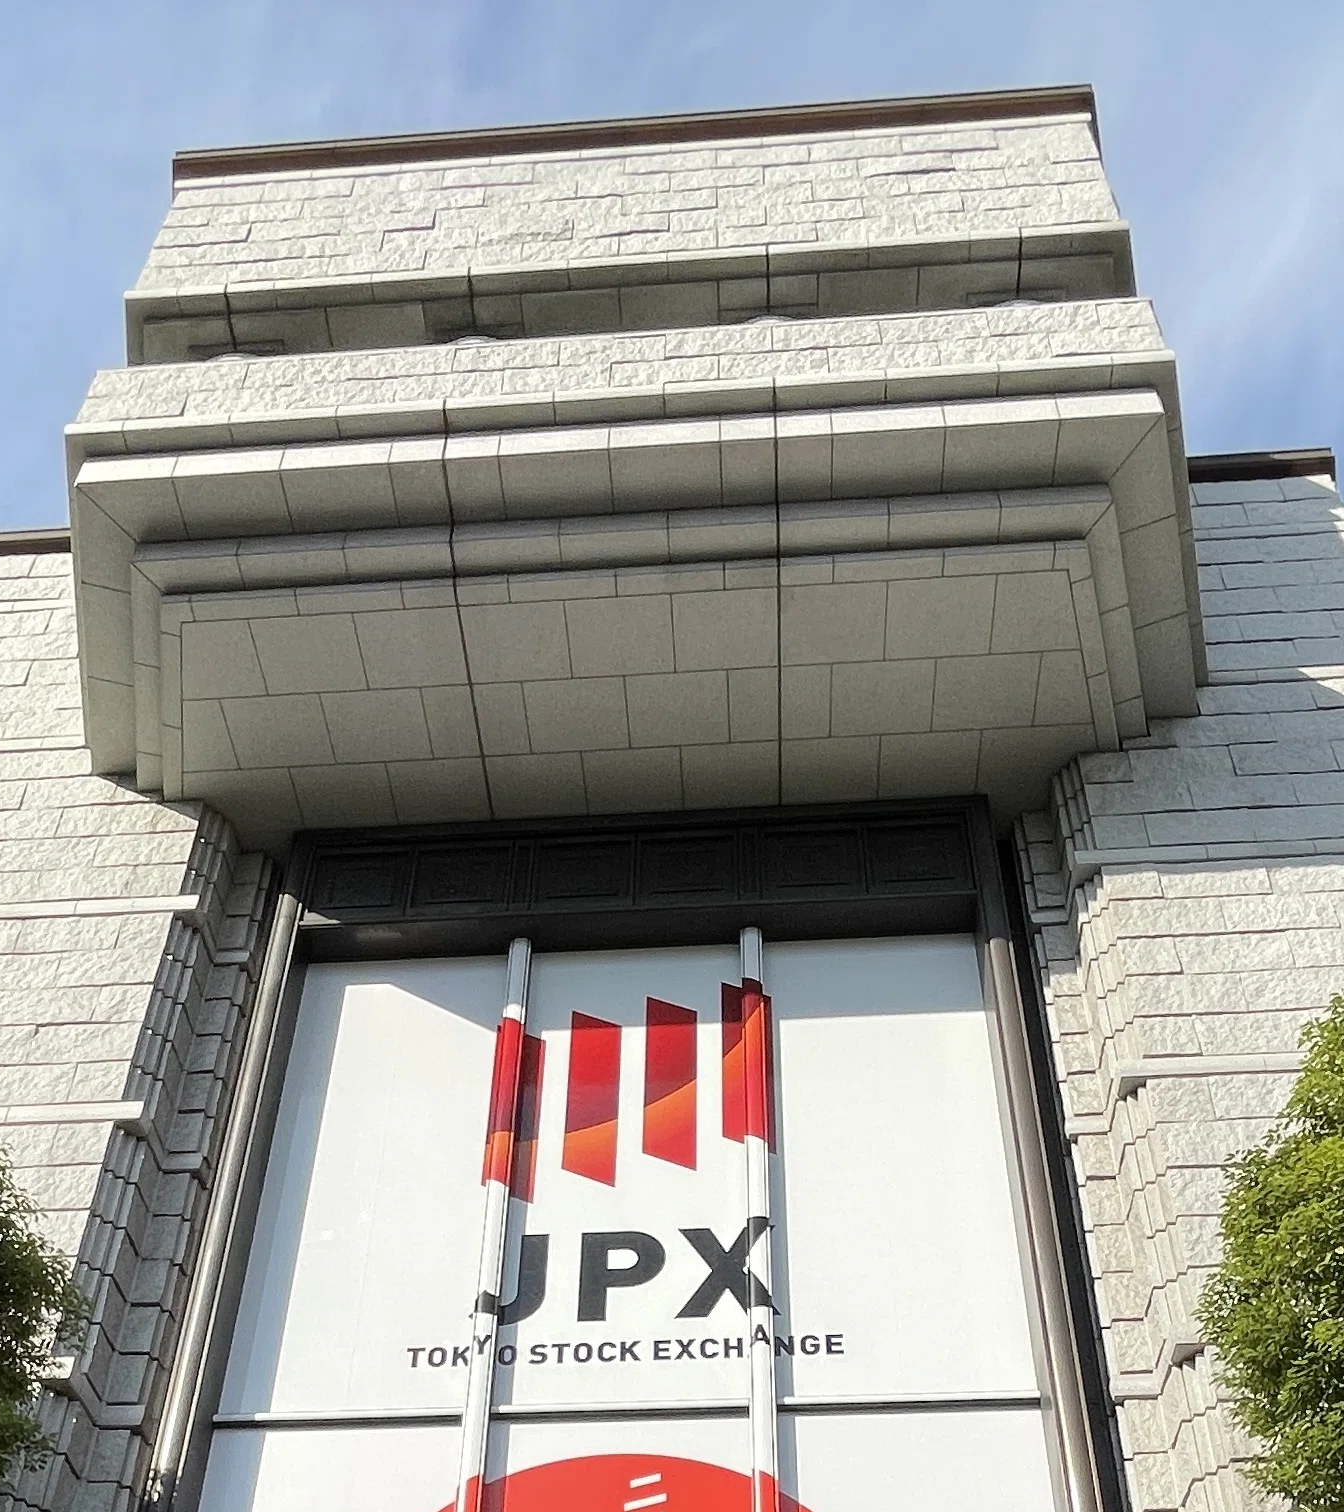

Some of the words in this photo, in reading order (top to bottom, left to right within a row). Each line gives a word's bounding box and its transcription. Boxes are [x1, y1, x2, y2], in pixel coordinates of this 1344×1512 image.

[468, 1215, 782, 1327] JPX
[406, 1333, 519, 1368] TOKYO
[528, 1338, 641, 1365] STOCK
[652, 1323, 846, 1361] EXCHANGE
